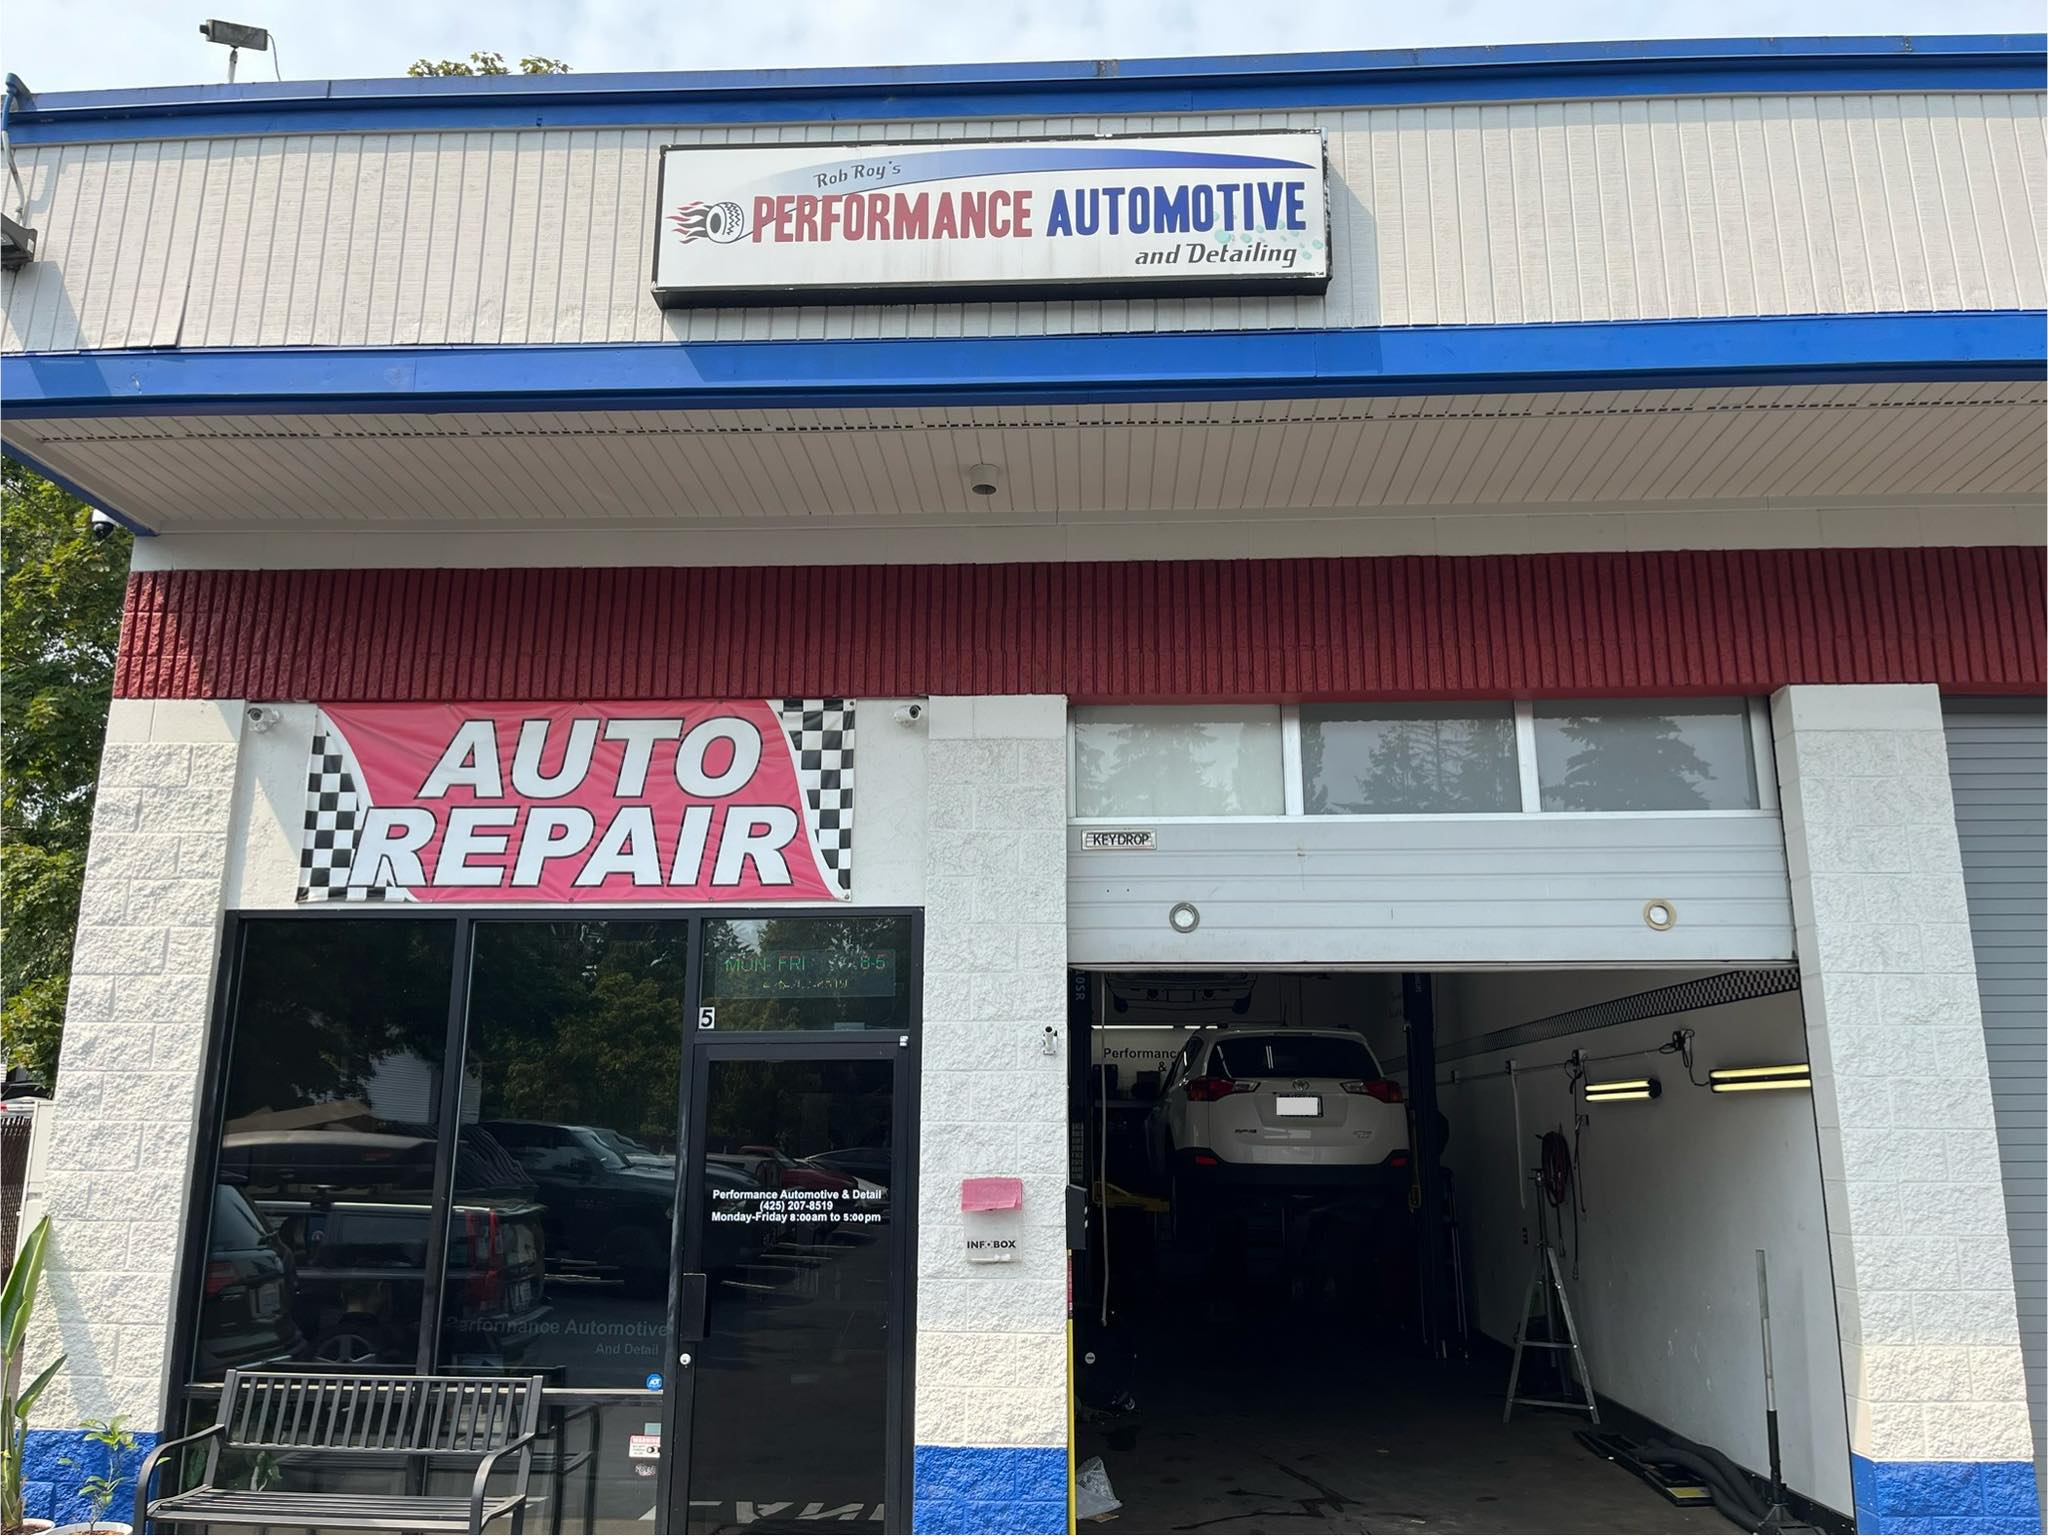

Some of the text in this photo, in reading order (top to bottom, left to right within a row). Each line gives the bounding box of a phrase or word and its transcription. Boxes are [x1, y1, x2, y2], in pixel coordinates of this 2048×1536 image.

[813, 160, 902, 188] Rob Roy's
[752, 181, 1307, 244] PERFORMANCE AUTOMOTIVE
[1134, 240, 1298, 269] and Detailing
[416, 716, 764, 800] AUTO
[346, 804, 801, 888] REPAIR
[700, 1009, 713, 1027] 5
[1103, 1048, 1180, 1059] Performanc
[712, 1189, 882, 1199] Performance Automotive & Detail
[759, 1200, 833, 1212] (425) 207-8519
[711, 1211, 881, 1223] Monday-Friday 8:00am to 5:00pm
[564, 1318, 667, 1337] Automotive
[594, 1344, 659, 1356] And Detail
